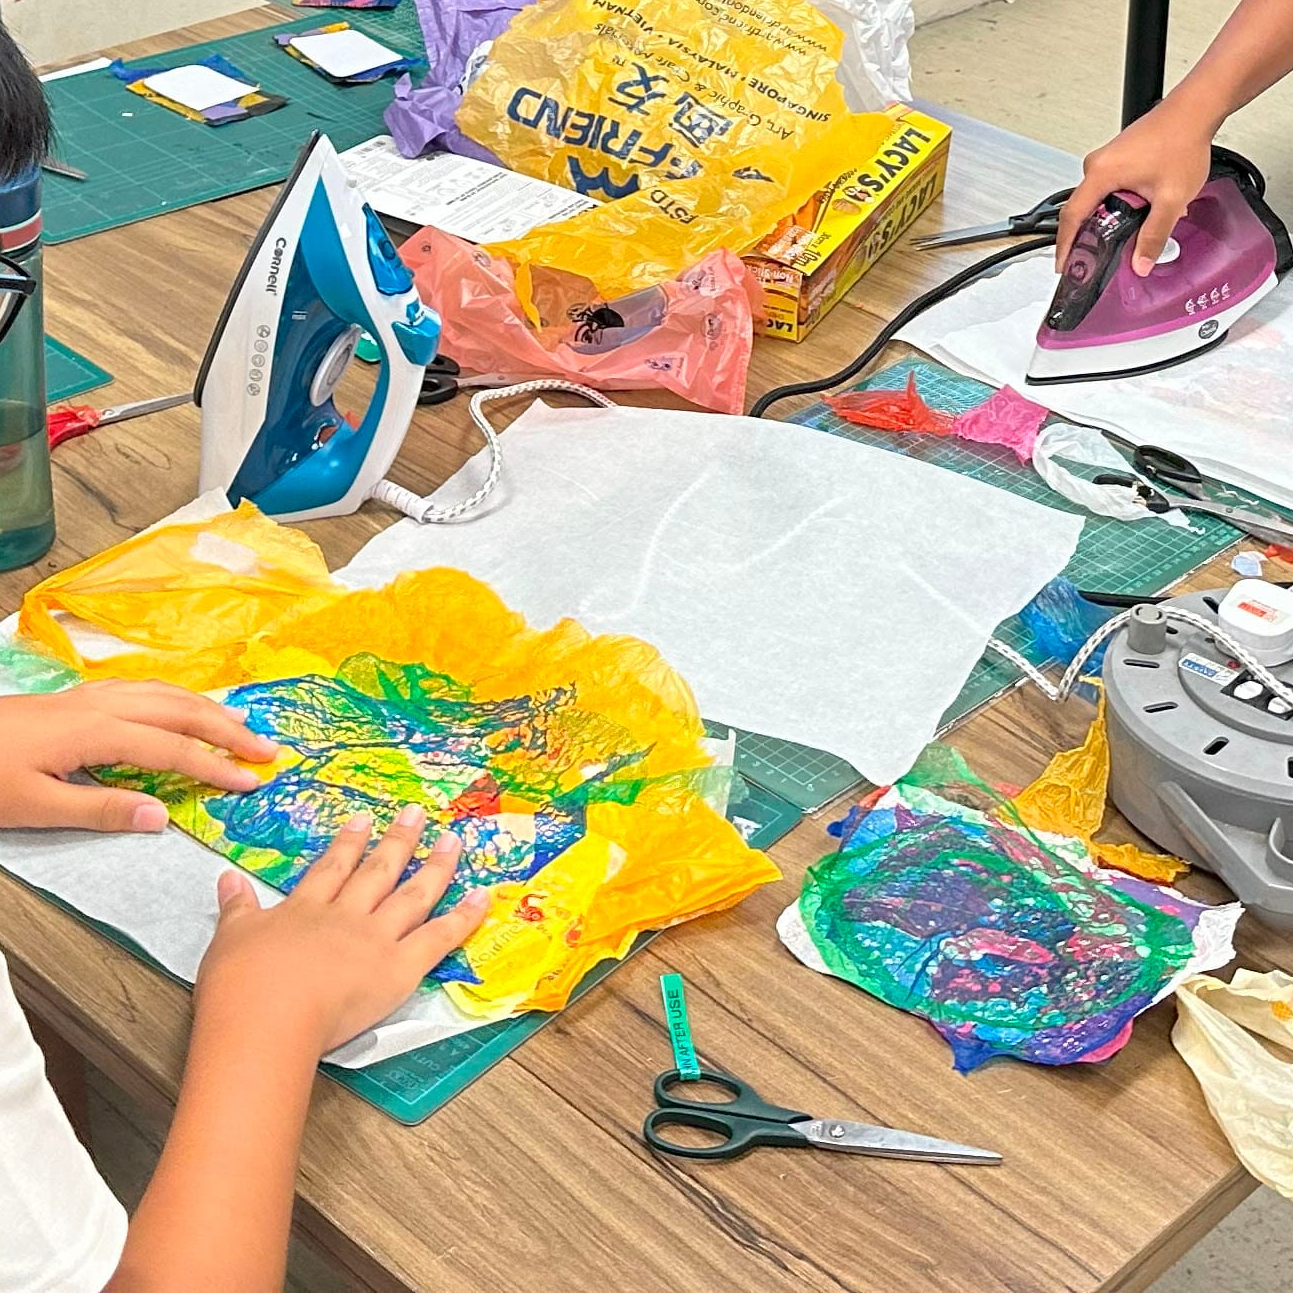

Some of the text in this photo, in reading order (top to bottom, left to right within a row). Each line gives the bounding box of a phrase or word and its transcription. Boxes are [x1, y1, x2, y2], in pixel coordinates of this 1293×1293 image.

[668, 38, 738, 80] MALAYSIA
[749, 78, 831, 122] SINGAPORE
[857, 127, 932, 195] LACY'S
[650, 189, 697, 225] ESTD
[667, 988, 683, 1019] USE
[673, 1022, 690, 1058] AFTER
